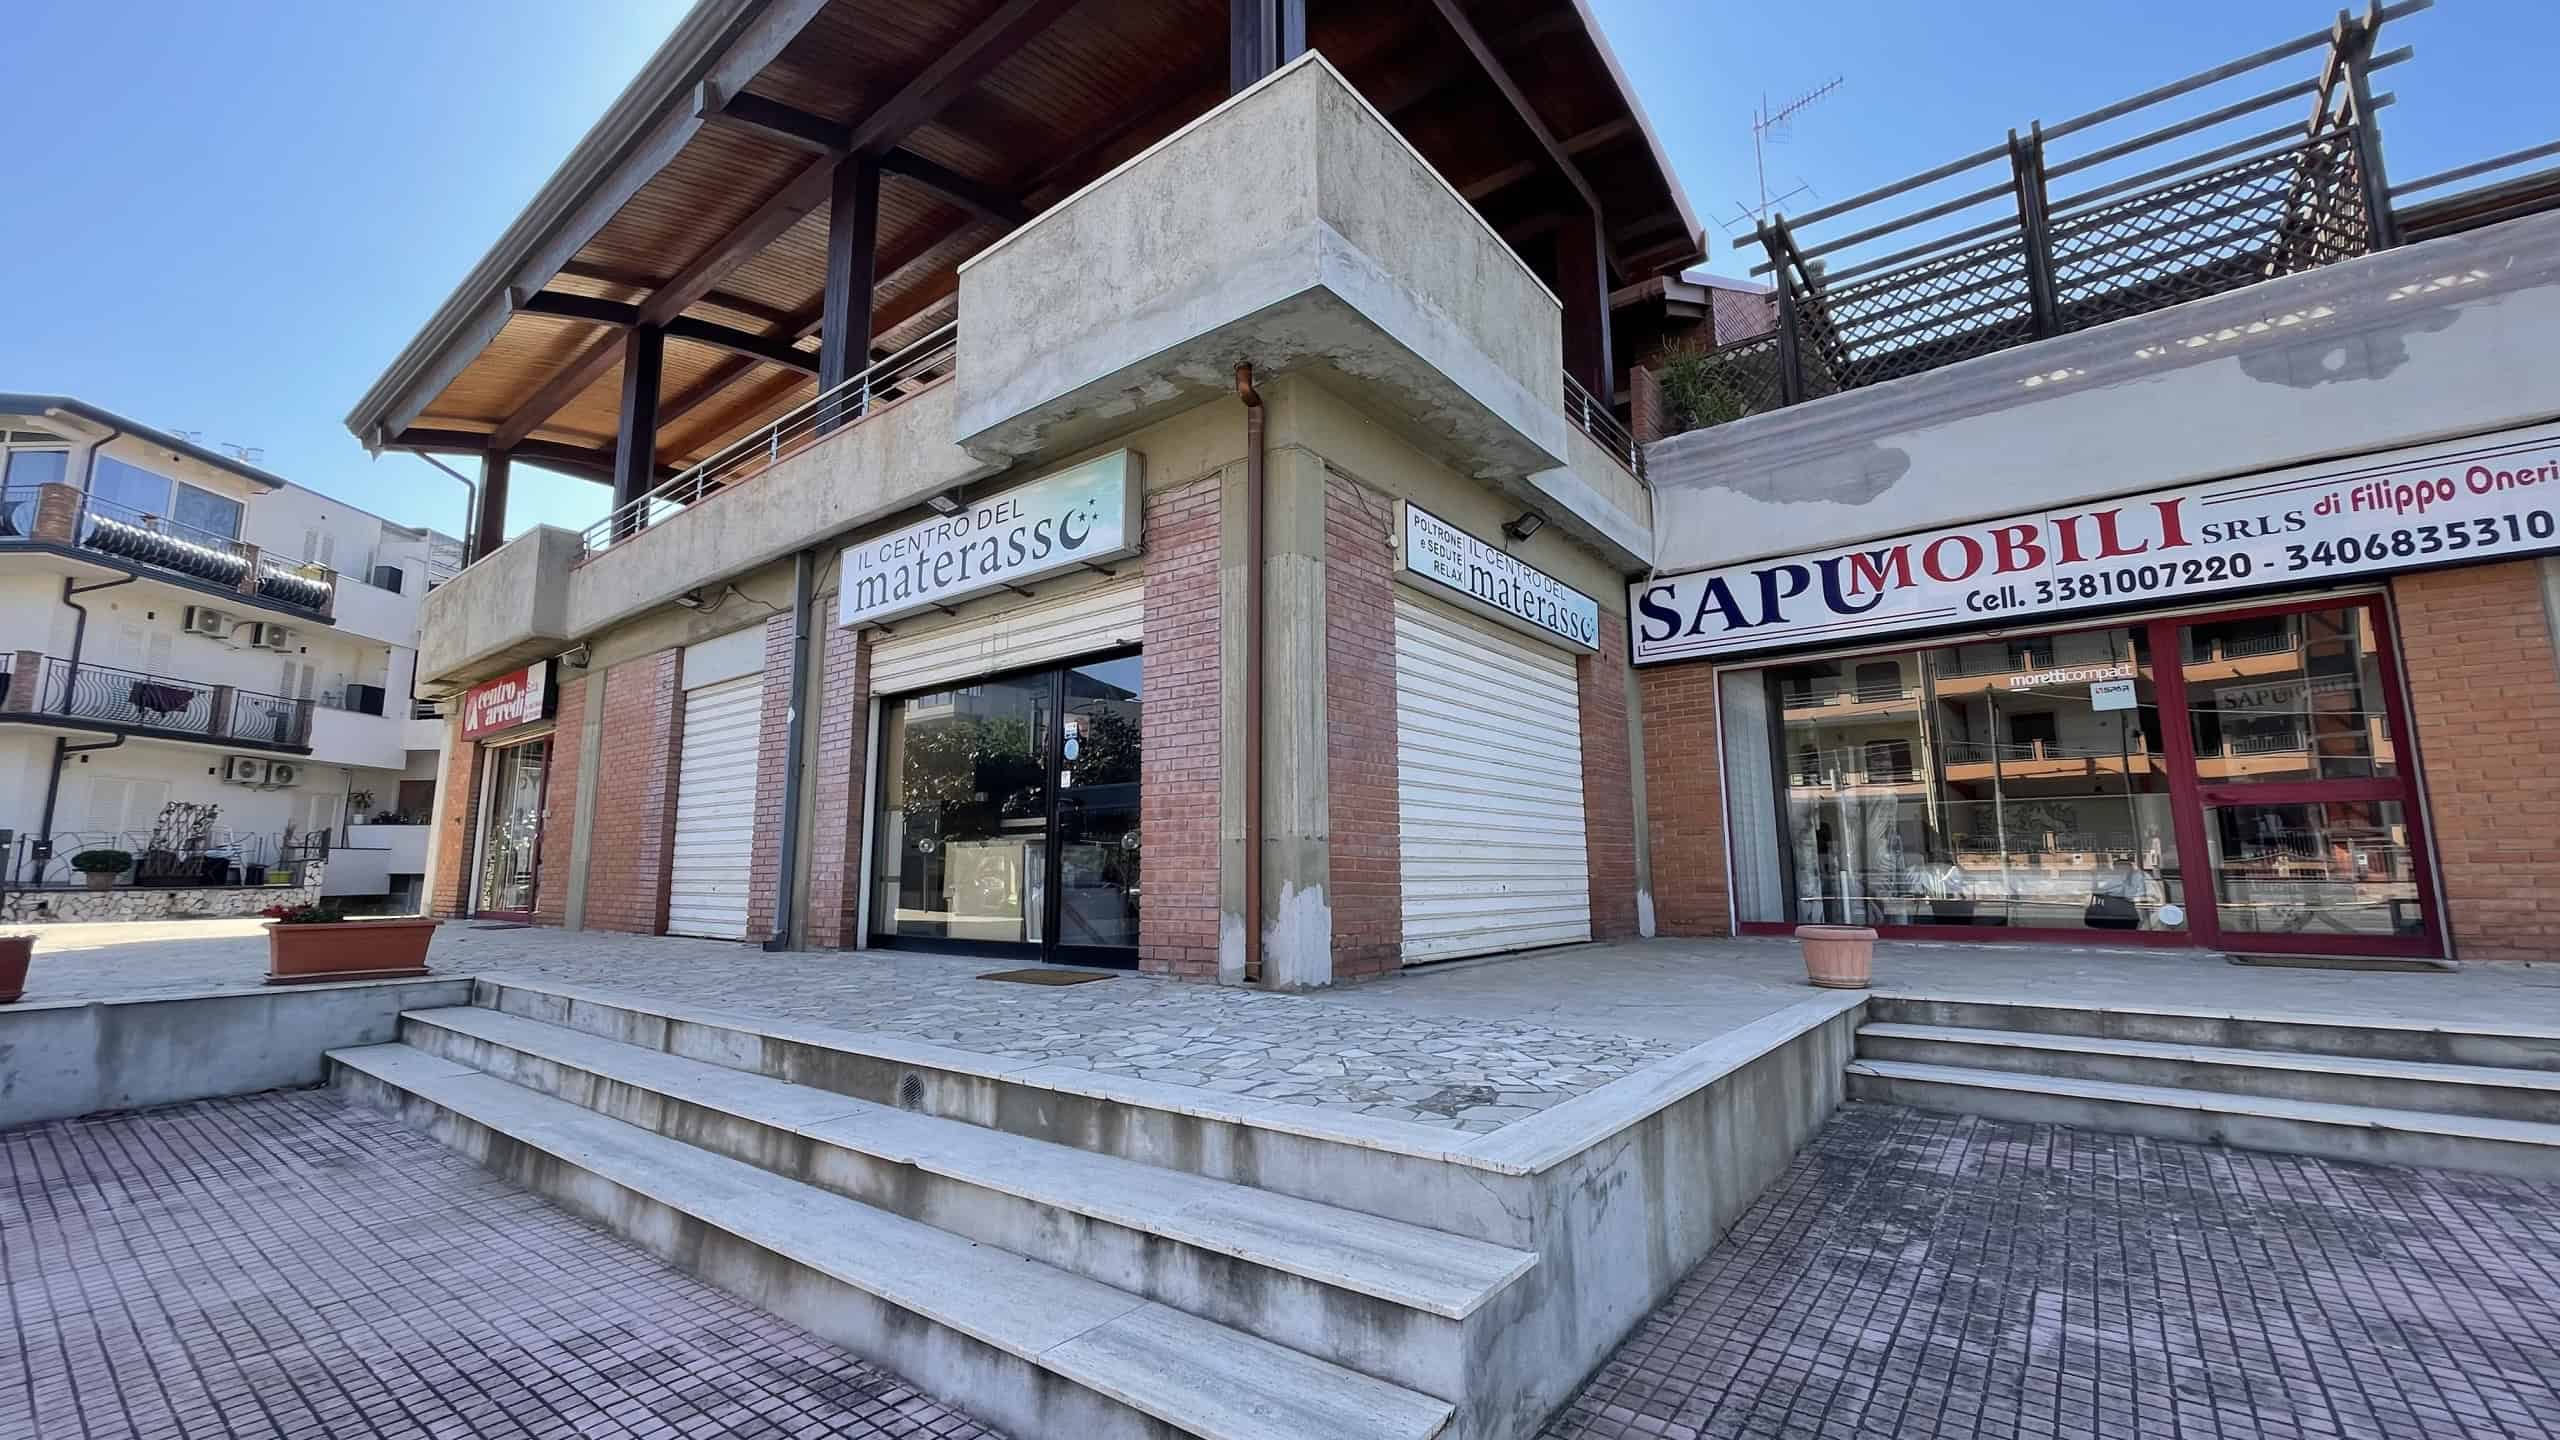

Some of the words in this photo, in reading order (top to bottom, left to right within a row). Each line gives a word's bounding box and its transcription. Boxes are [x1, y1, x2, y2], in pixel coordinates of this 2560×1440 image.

[2313, 492, 2341, 516] di
[2351, 478, 2456, 516] Filippo
[858, 553, 873, 571] IL
[879, 516, 970, 563] CENTRO
[977, 498, 1025, 530] DEL
[1414, 514, 1463, 550] POLTRONE
[2202, 510, 2306, 544] SRLS
[854, 507, 1091, 613] materasso
[1420, 539, 1427, 549] e
[1427, 539, 1463, 566] SEDUTE
[1469, 538, 1481, 559] IL
[1485, 548, 1541, 588] CENTRO
[1544, 576, 1566, 600] DEL
[1967, 583, 2026, 612] Cell.
[2036, 551, 2252, 605] 3381007220
[2285, 509, 2555, 572] 3406835310
[1434, 560, 1463, 584] RELAX
[1469, 564, 1593, 643] materasso
[2009, 663, 2132, 687] moretticompact
[478, 681, 516, 710] centro
[485, 689, 525, 727] arredi
